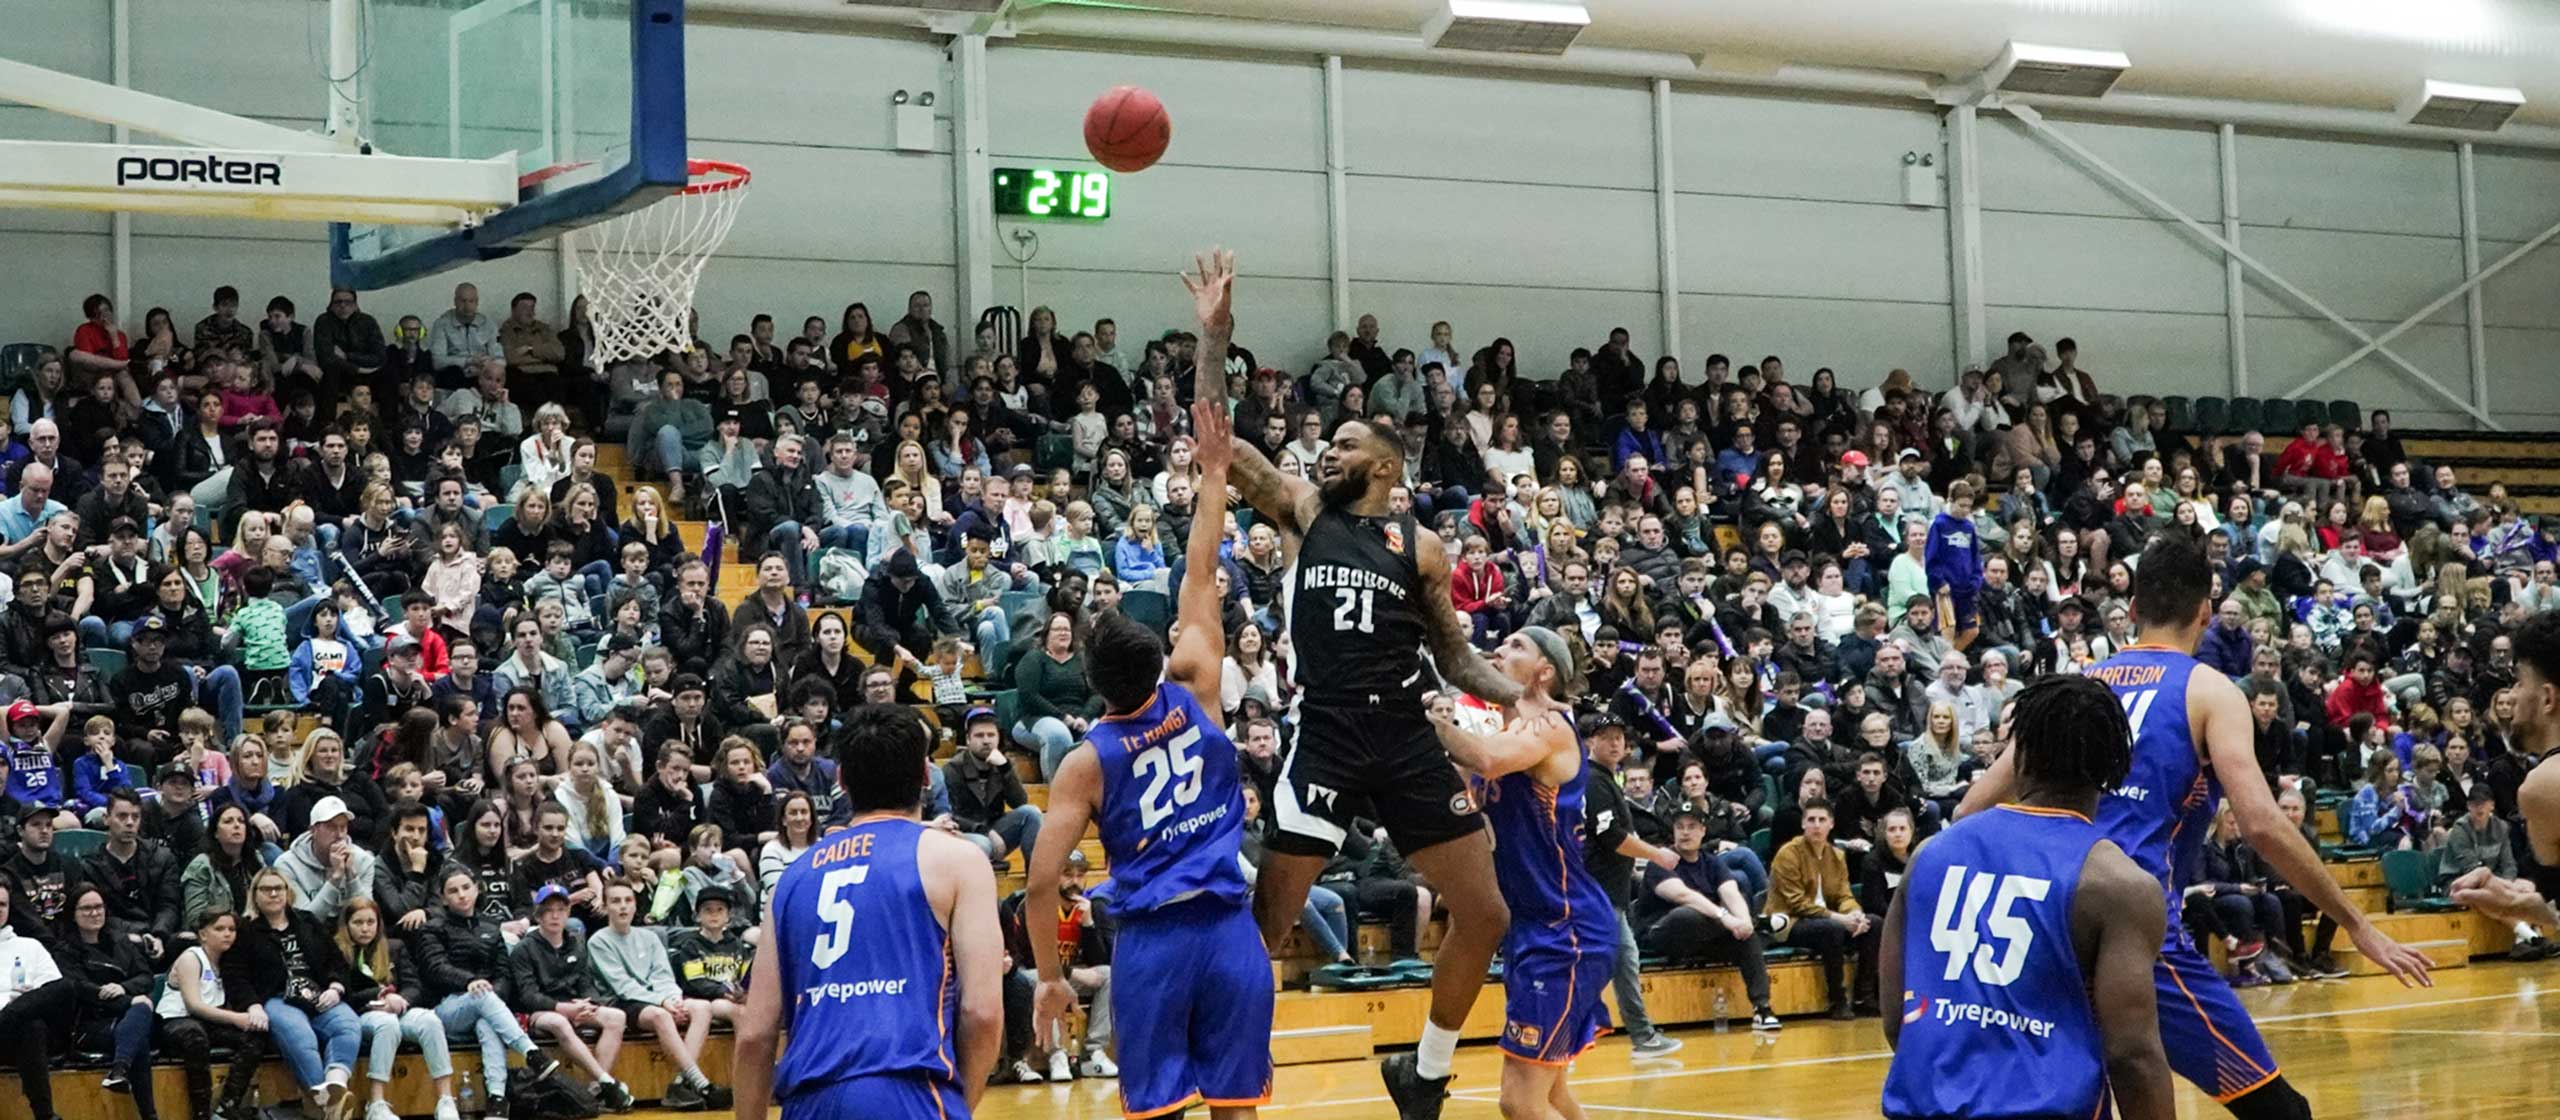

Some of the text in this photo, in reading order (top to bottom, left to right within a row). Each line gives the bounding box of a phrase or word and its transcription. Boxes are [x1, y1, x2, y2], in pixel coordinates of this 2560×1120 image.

[1027, 169, 1109, 217] 2:19
[1333, 587, 1375, 634] 21
[25, 771, 48, 787] 25
[1132, 725, 1204, 831] 25
[812, 833, 876, 869] CADEE
[811, 865, 870, 970] 5
[1930, 866, 2052, 987] 45
[1367, 1001, 1385, 1013] 29
[1935, 999, 2055, 1039] Tyrepower
